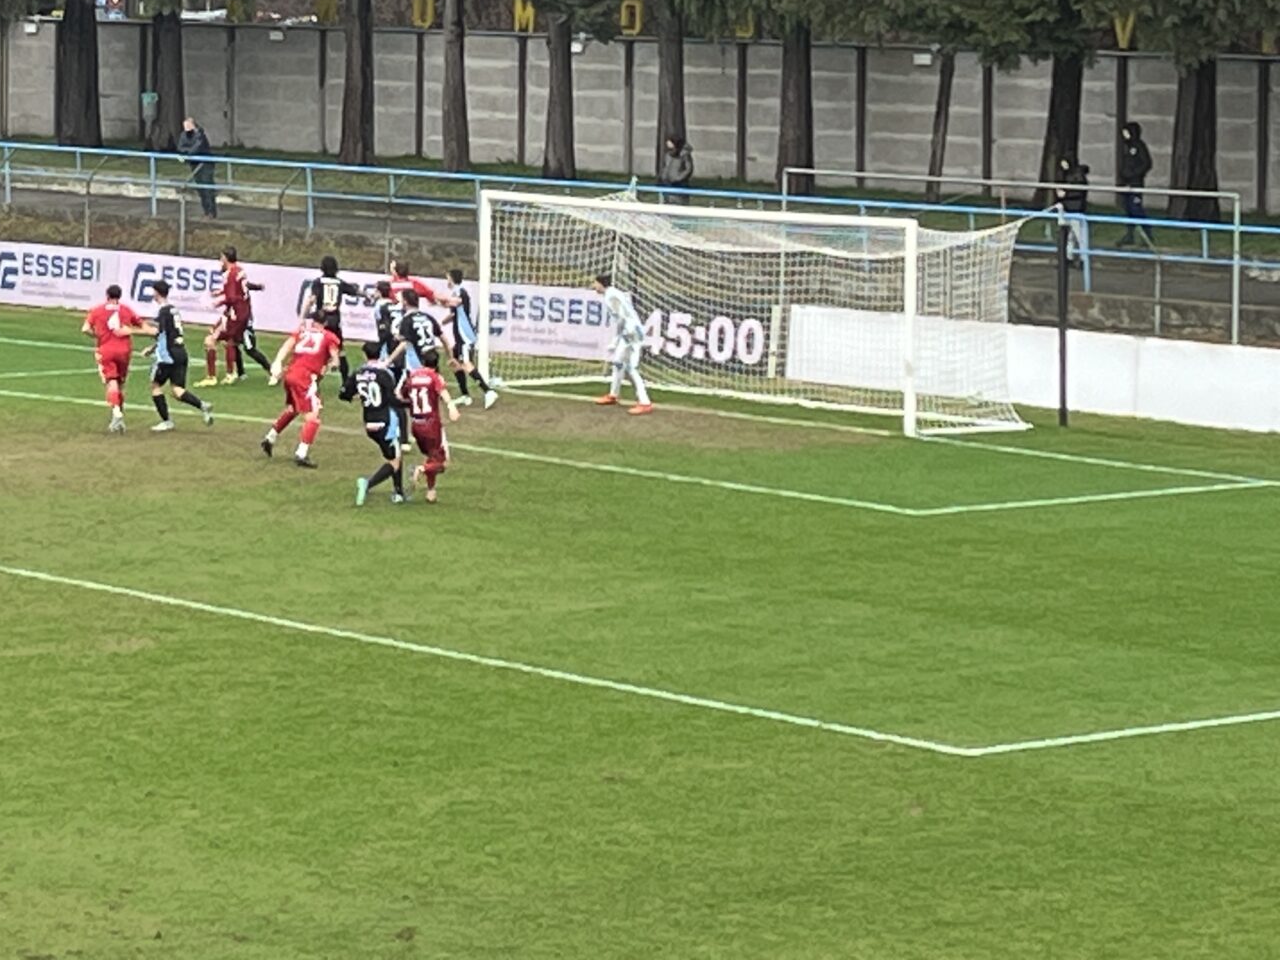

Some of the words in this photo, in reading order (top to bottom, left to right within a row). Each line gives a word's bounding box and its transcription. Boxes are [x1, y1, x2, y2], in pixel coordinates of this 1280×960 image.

[22, 252, 101, 282] ESSEBI
[162, 266, 224, 292] ESSE
[642, 307, 765, 365] 45:00
[356, 381, 382, 407] 50
[409, 386, 433, 414] 11
